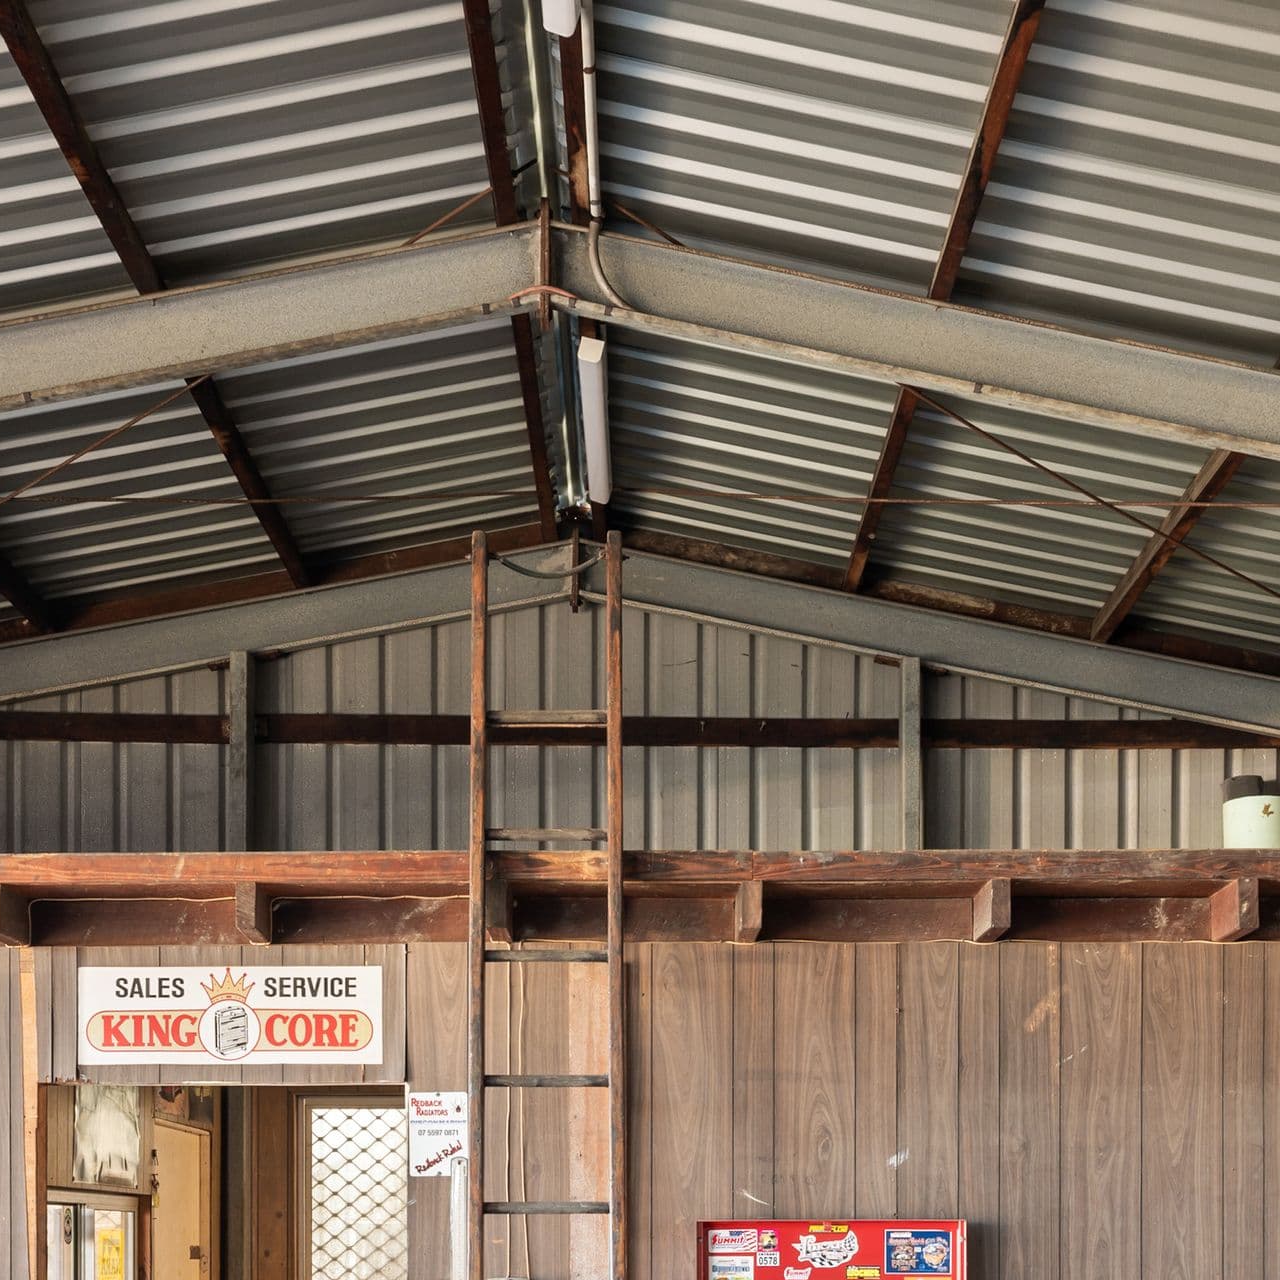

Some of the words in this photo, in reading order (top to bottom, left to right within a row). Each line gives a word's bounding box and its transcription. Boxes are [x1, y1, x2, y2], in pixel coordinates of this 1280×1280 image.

[115, 977, 185, 999] SALES
[264, 976, 358, 998] SERVICE
[101, 1014, 200, 1048] KING
[265, 1013, 359, 1048] CORE
[758, 1257, 778, 1265] 0578
